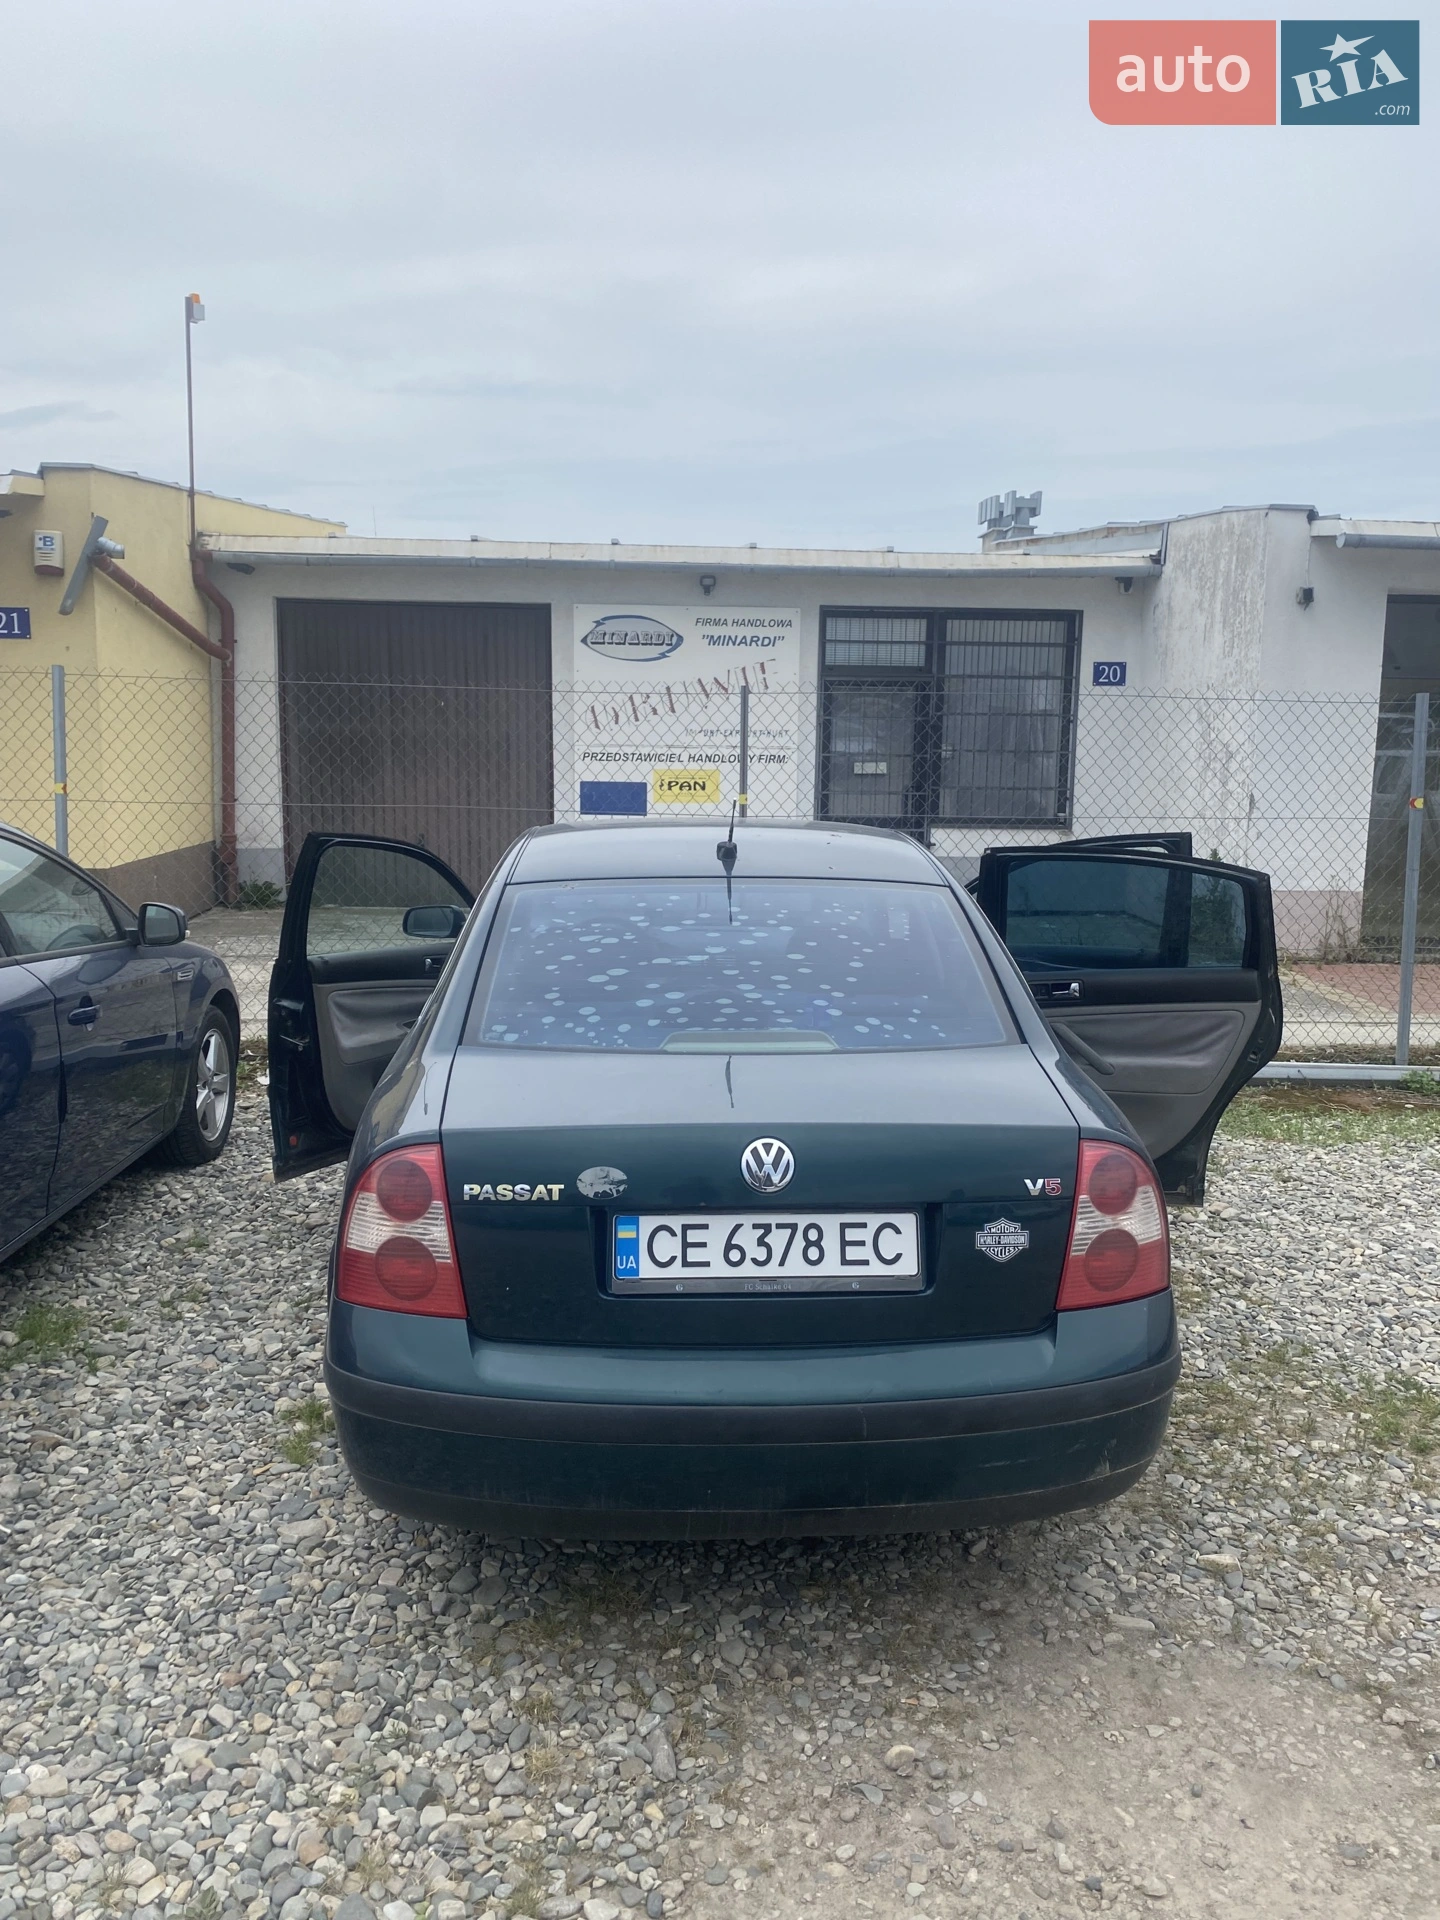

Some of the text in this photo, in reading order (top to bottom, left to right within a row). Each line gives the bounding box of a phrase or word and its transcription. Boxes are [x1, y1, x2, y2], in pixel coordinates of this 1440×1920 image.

[695, 617, 793, 628] FIRMA HANDLOWA
[590, 630, 675, 646] MINARDI
[1098, 665, 1121, 682] 20
[582, 752, 789, 764] PRZEDSTAWICIEL HANDLOY FIRM:
[463, 1183, 564, 1201] PASSAT
[1023, 1178, 1062, 1196] V5
[990, 1223, 1016, 1234] MOTOR
[647, 1221, 904, 1268] CE 6378 EC
[979, 1235, 1026, 1245] HARLEY-DAVIDSON
[990, 1246, 1015, 1258] CYCLES
[617, 1255, 637, 1270] UA
